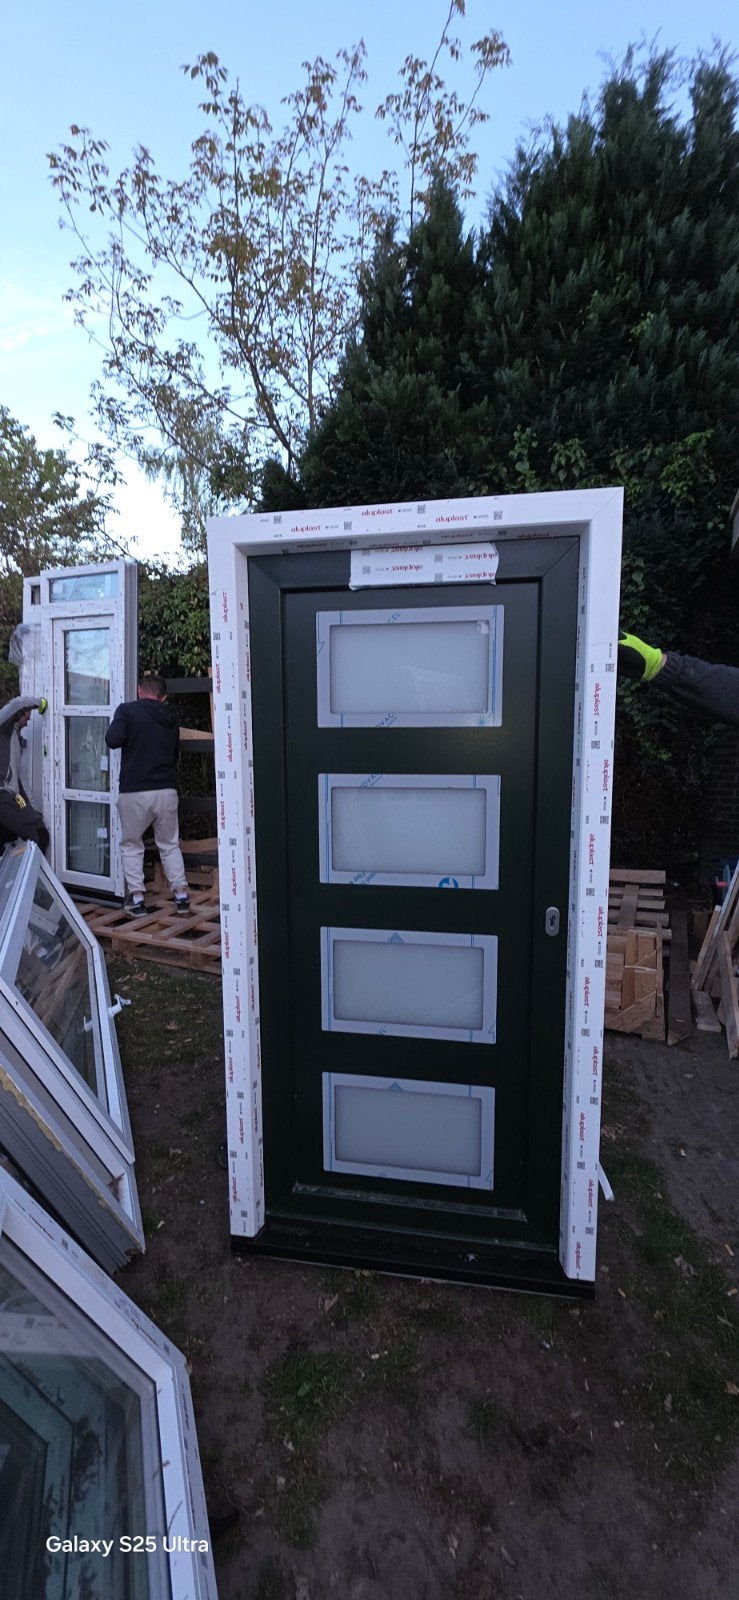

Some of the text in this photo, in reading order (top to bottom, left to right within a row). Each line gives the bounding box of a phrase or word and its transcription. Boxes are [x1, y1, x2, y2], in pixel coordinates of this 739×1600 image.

[361, 508, 394, 517] aluplast
[435, 514, 469, 523] aluplast
[291, 524, 321, 533] aluplast
[464, 552, 498, 561] aluplast
[391, 563, 424, 572] aluplast
[594, 682, 602, 716] aluplast
[602, 758, 610, 792] aluplast
